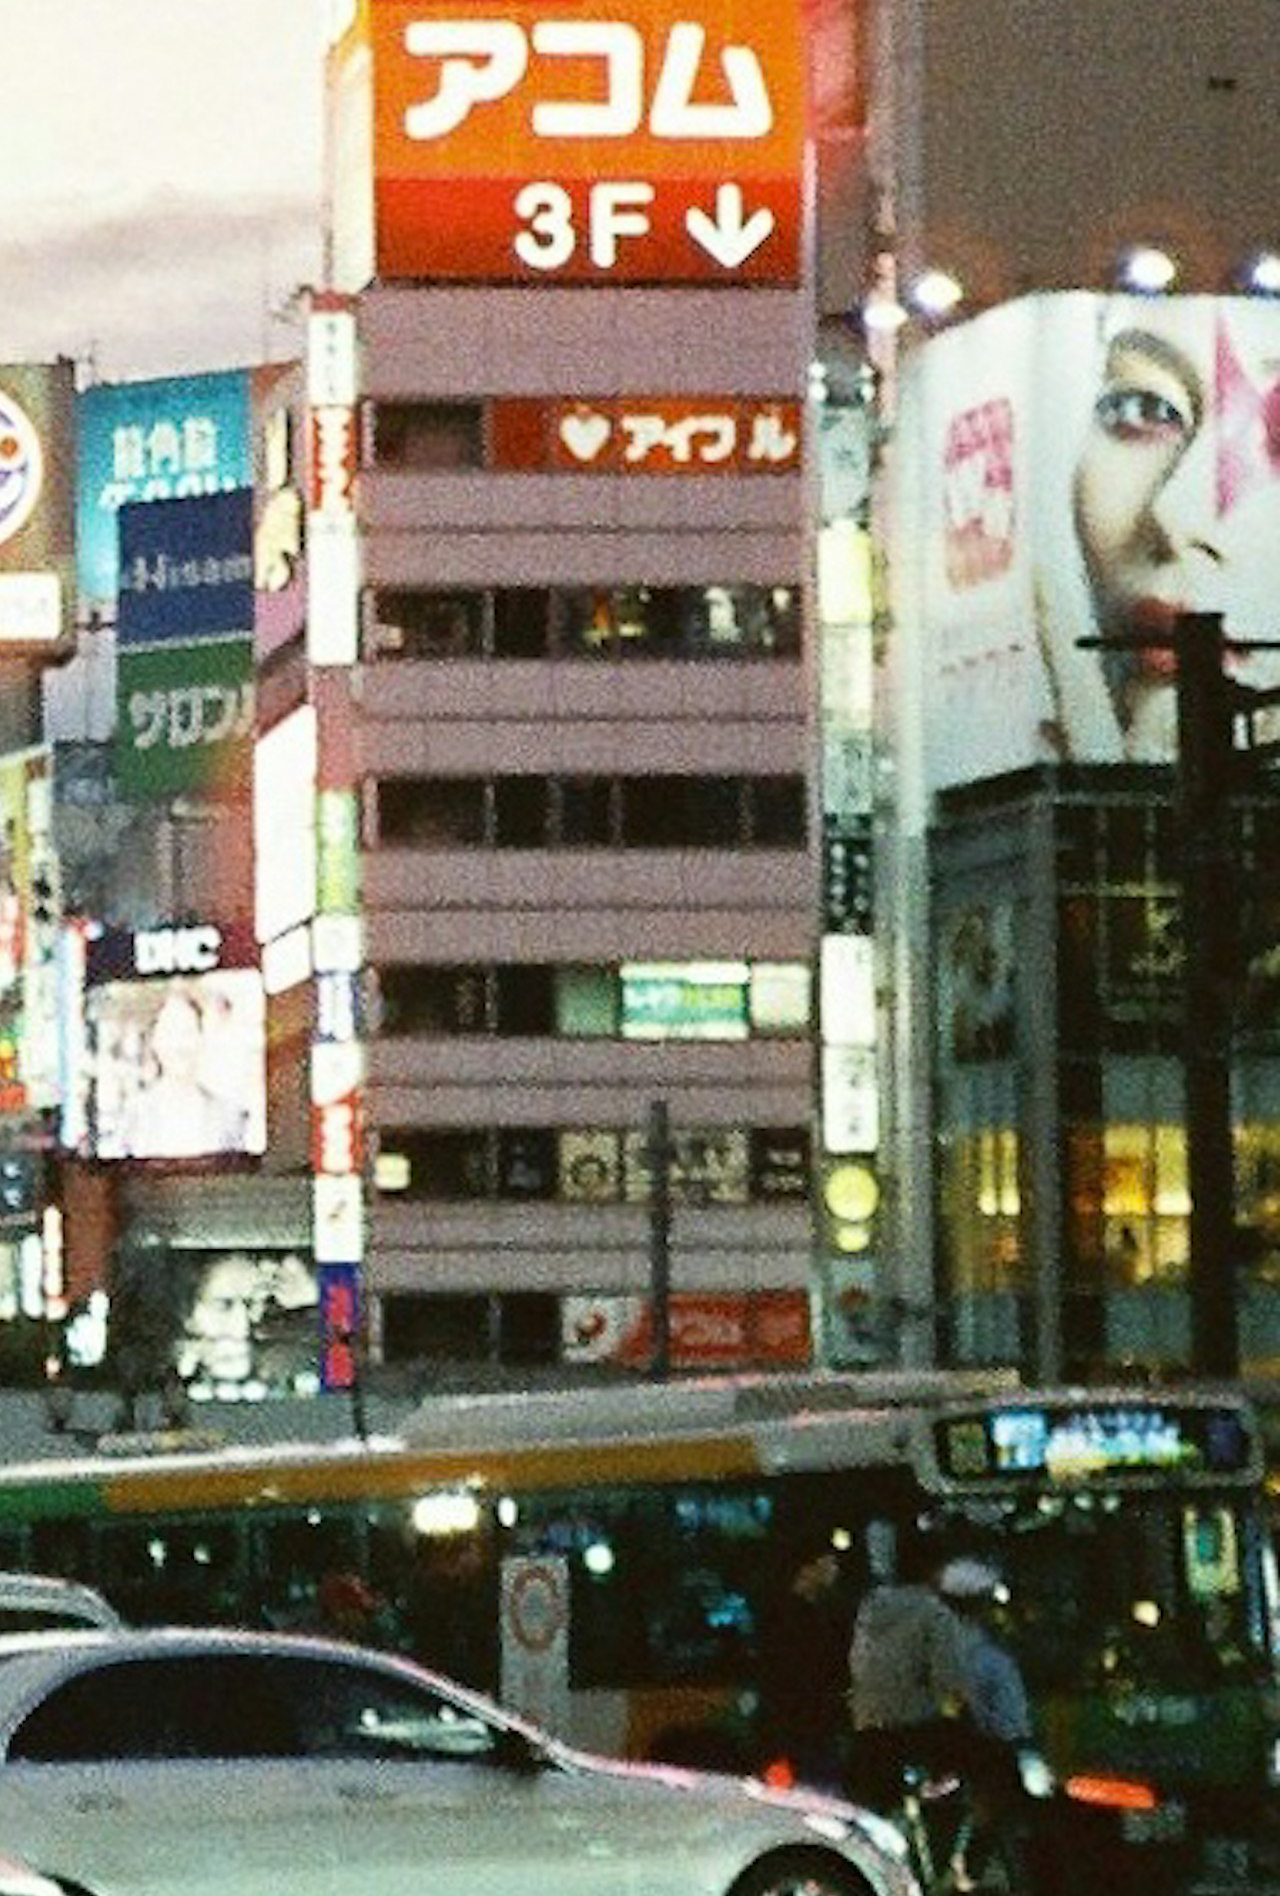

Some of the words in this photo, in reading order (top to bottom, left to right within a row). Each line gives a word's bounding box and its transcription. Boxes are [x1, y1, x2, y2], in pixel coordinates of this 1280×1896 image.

[404, 20, 773, 140] アコム
[514, 182, 655, 268] 3F
[622, 412, 797, 462] アイフル
